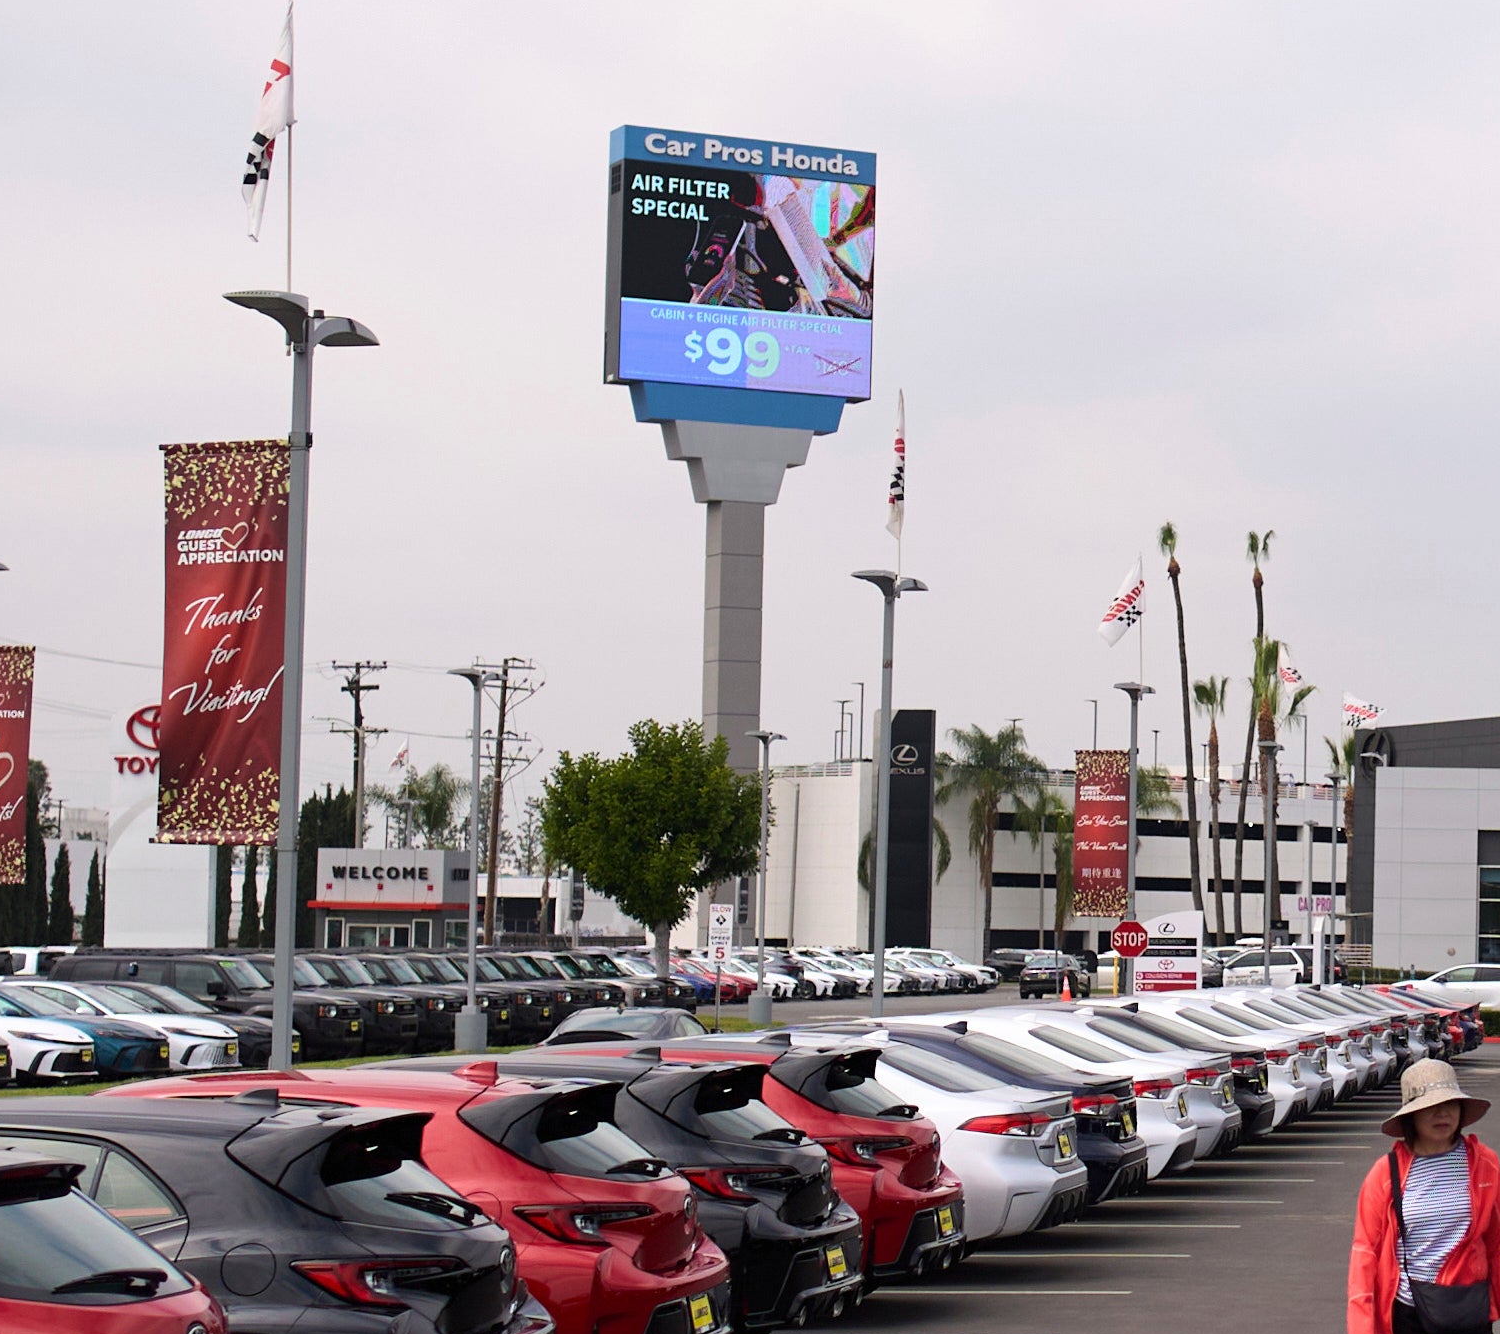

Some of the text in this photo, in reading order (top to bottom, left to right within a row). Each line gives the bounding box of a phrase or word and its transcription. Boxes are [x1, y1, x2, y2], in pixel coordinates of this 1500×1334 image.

[644, 133, 859, 175] Car Pros Honda
[631, 174, 730, 200] AIR FILTER
[631, 198, 709, 222] SPECIAL
[651, 308, 685, 321] CABIN
[697, 312, 738, 326] ENGINE
[740, 315, 759, 327] AIR
[761, 318, 797, 331] FILTER
[799, 321, 843, 334] SPECIAL
[684, 327, 781, 378] $99
[177, 539, 223, 552] GUEST
[178, 528, 223, 540] LONGO
[177, 550, 284, 566] APPRECIATION
[185, 587, 263, 635] Thanks
[205, 634, 241, 674] for
[169, 665, 285, 723] Visiting!
[114, 756, 160, 774] TOY
[332, 866, 429, 881] WELCOME
[1113, 932, 1146, 947] STOP
[715, 947, 725, 959] 5
